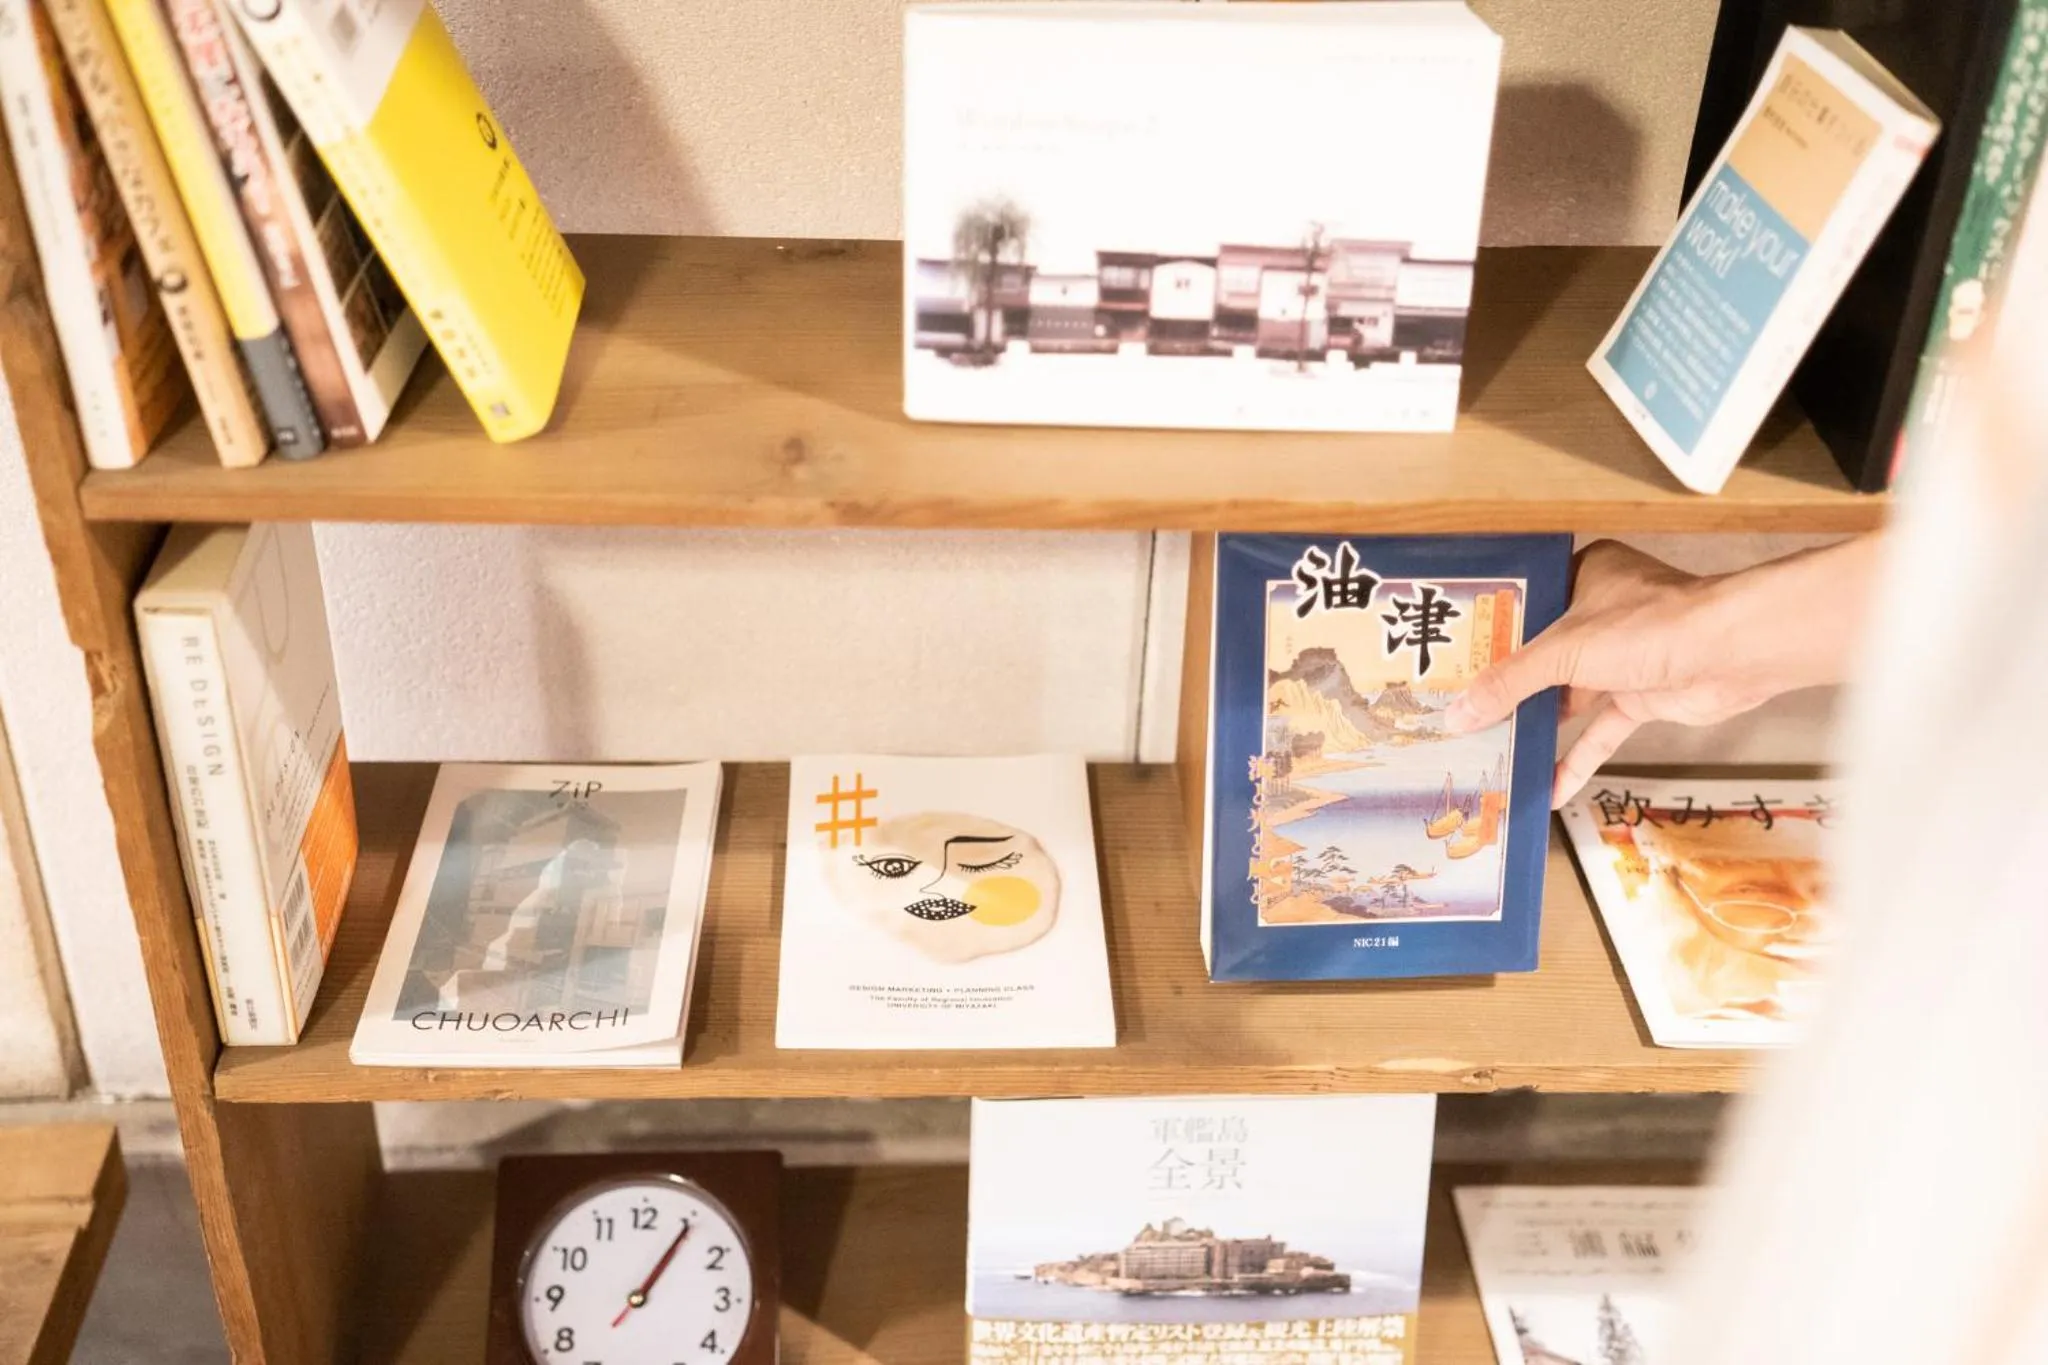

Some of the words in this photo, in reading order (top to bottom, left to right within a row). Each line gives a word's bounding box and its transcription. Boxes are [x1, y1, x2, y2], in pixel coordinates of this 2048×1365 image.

[1704, 179, 1757, 240] make
[1740, 219, 1800, 279] your
[1295, 544, 1461, 676] 油津
[887, 985, 944, 994] MARKETING
[953, 986, 1002, 994] PLANNING
[1003, 984, 1035, 992] CLASS
[411, 1007, 630, 1032] CHUOARCHI
[1146, 1147, 1247, 1190] 全景
[594, 1217, 614, 1241] 11
[630, 1206, 658, 1230] 12
[560, 1246, 588, 1272] 10
[705, 1246, 725, 1270] 2
[545, 1284, 565, 1311] 9
[713, 1286, 731, 1312] 3
[554, 1327, 575, 1352] 8
[699, 1329, 718, 1353] 4
